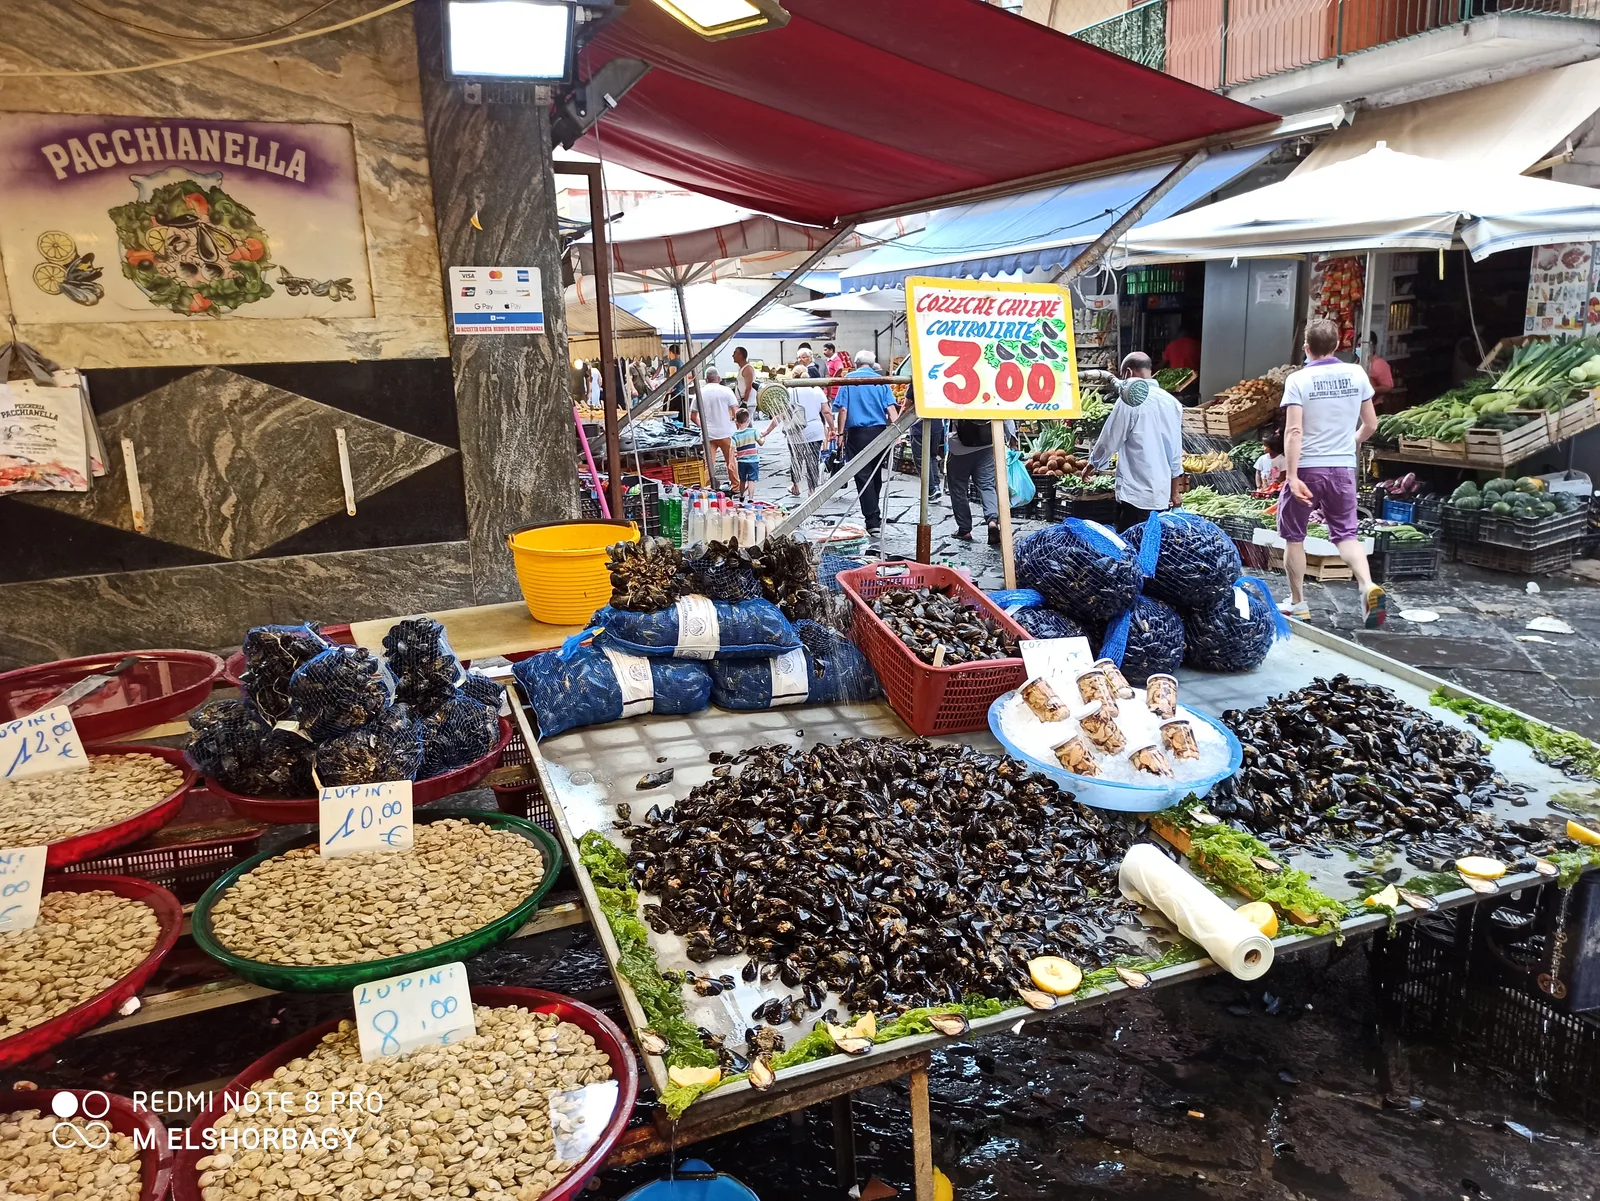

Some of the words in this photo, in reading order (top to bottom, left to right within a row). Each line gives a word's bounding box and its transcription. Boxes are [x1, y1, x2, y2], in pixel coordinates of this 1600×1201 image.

[41, 127, 306, 183] PACCHIANELLA
[997, 298, 1062, 318] CHIENE
[926, 319, 1037, 340] CONTROLLATE
[0, 409, 58, 421] PACCHIANELLA
[57, 742, 79, 758] €
[325, 800, 402, 846] 10,00
[379, 825, 408, 847] €
[437, 1029, 461, 1045] €
